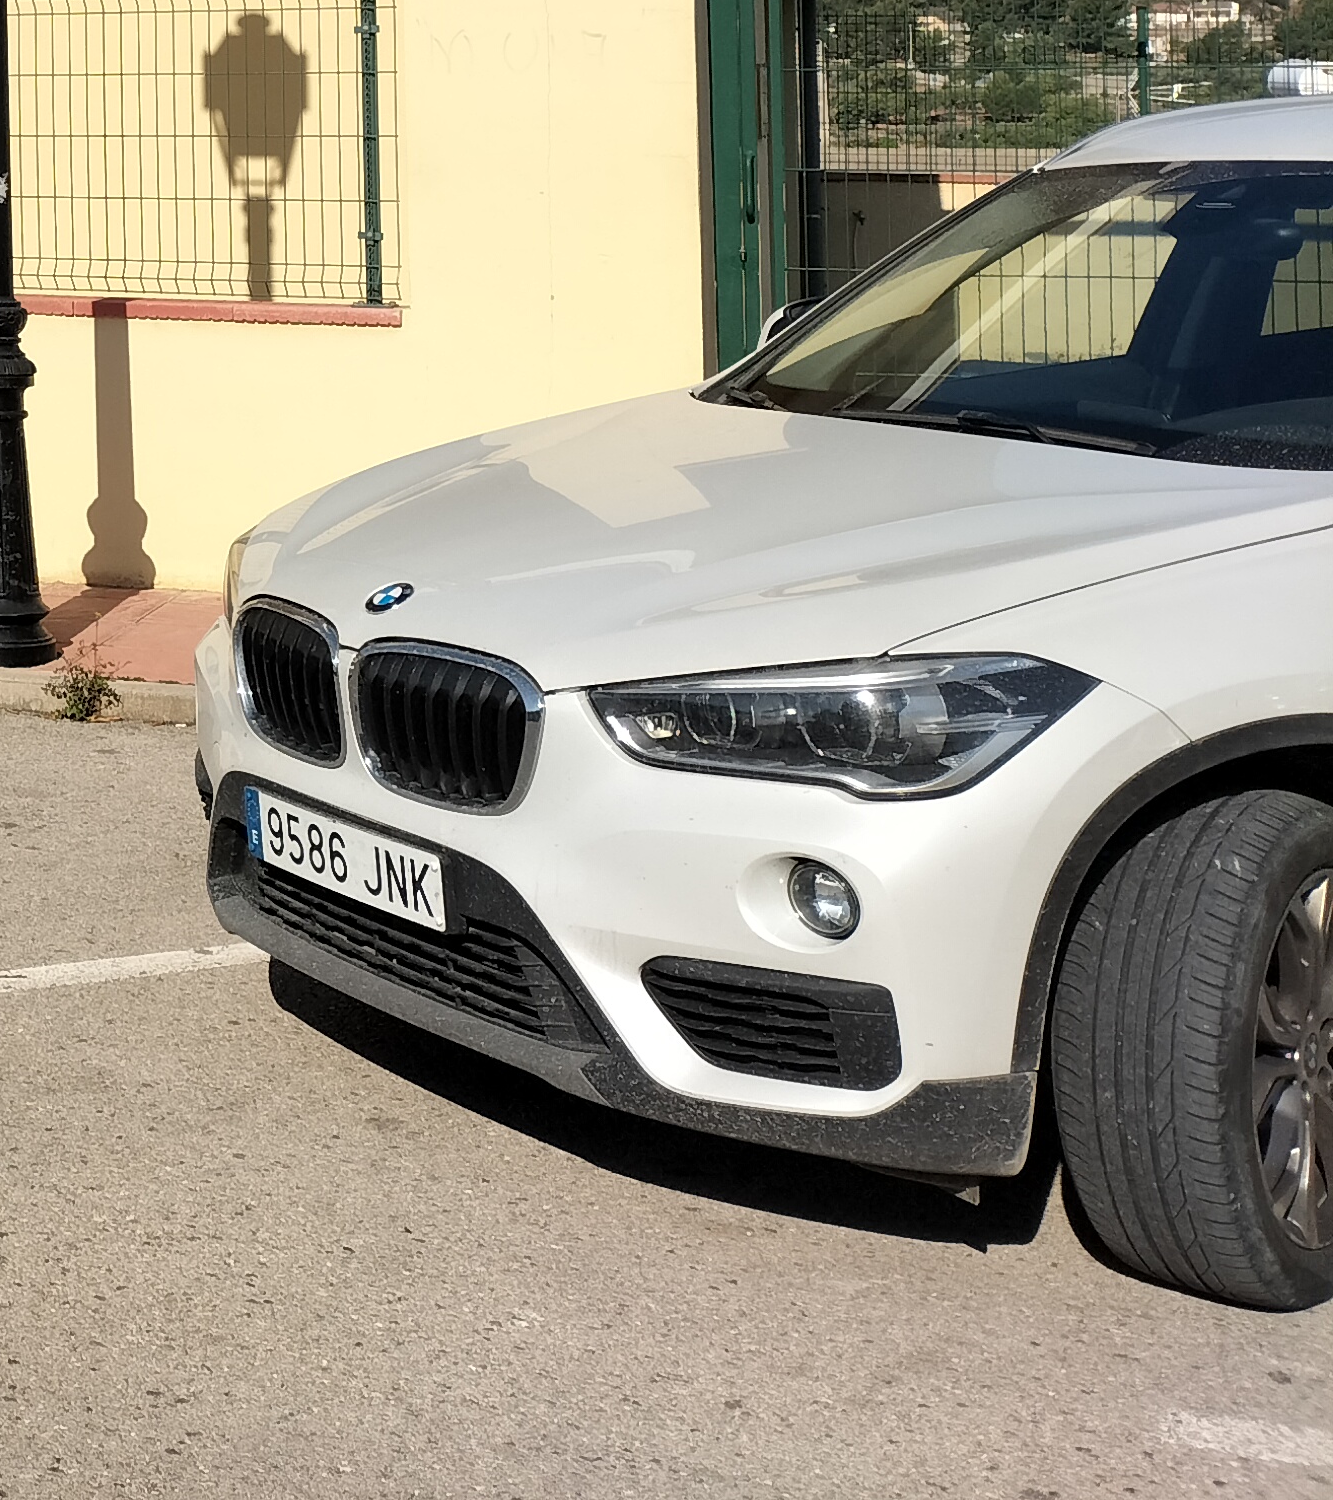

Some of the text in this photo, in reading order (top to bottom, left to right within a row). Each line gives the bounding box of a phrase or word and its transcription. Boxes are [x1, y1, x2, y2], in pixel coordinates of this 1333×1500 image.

[251, 829, 259, 845] E
[267, 806, 435, 918] 9586 JNK
